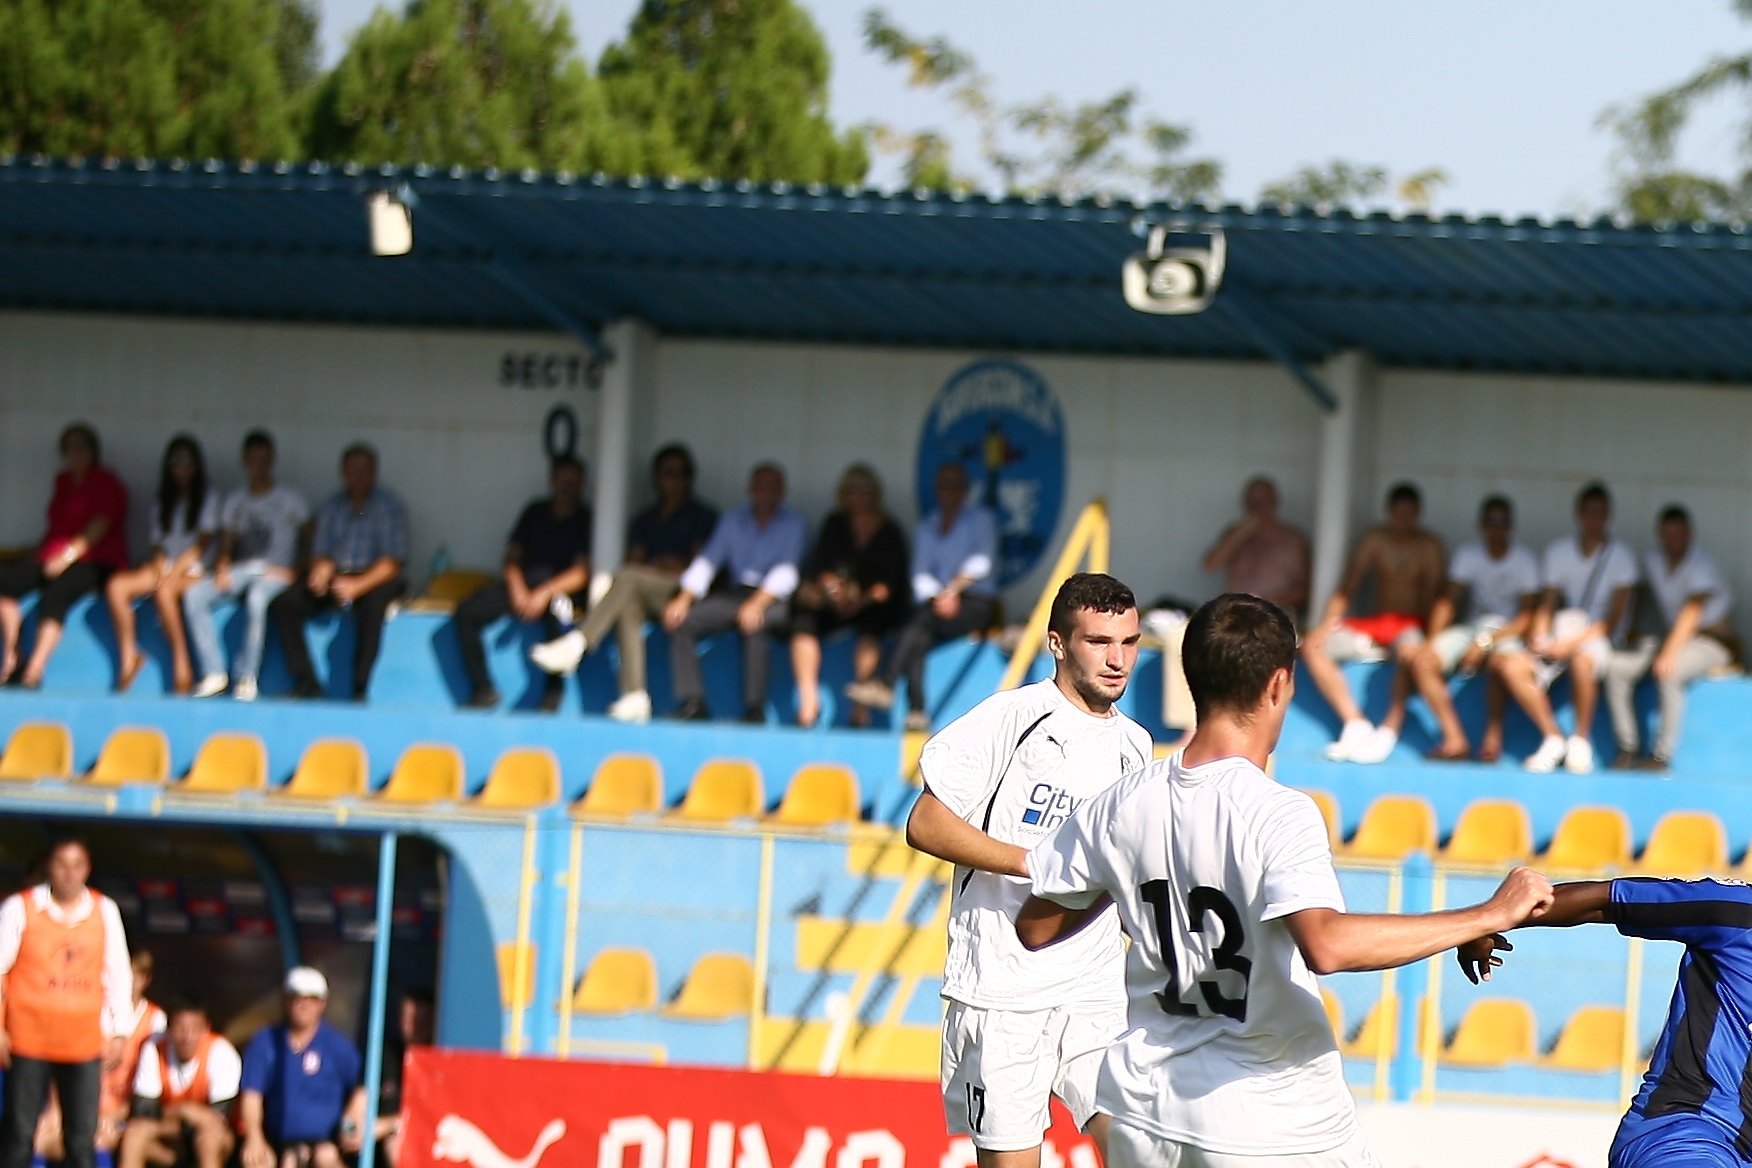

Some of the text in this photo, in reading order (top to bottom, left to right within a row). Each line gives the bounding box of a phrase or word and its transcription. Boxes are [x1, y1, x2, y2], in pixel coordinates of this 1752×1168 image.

[500, 353, 603, 390] SECTO
[1030, 782, 1083, 818] City
[1140, 878, 1252, 1023] 13
[966, 1082, 986, 1133] 17
